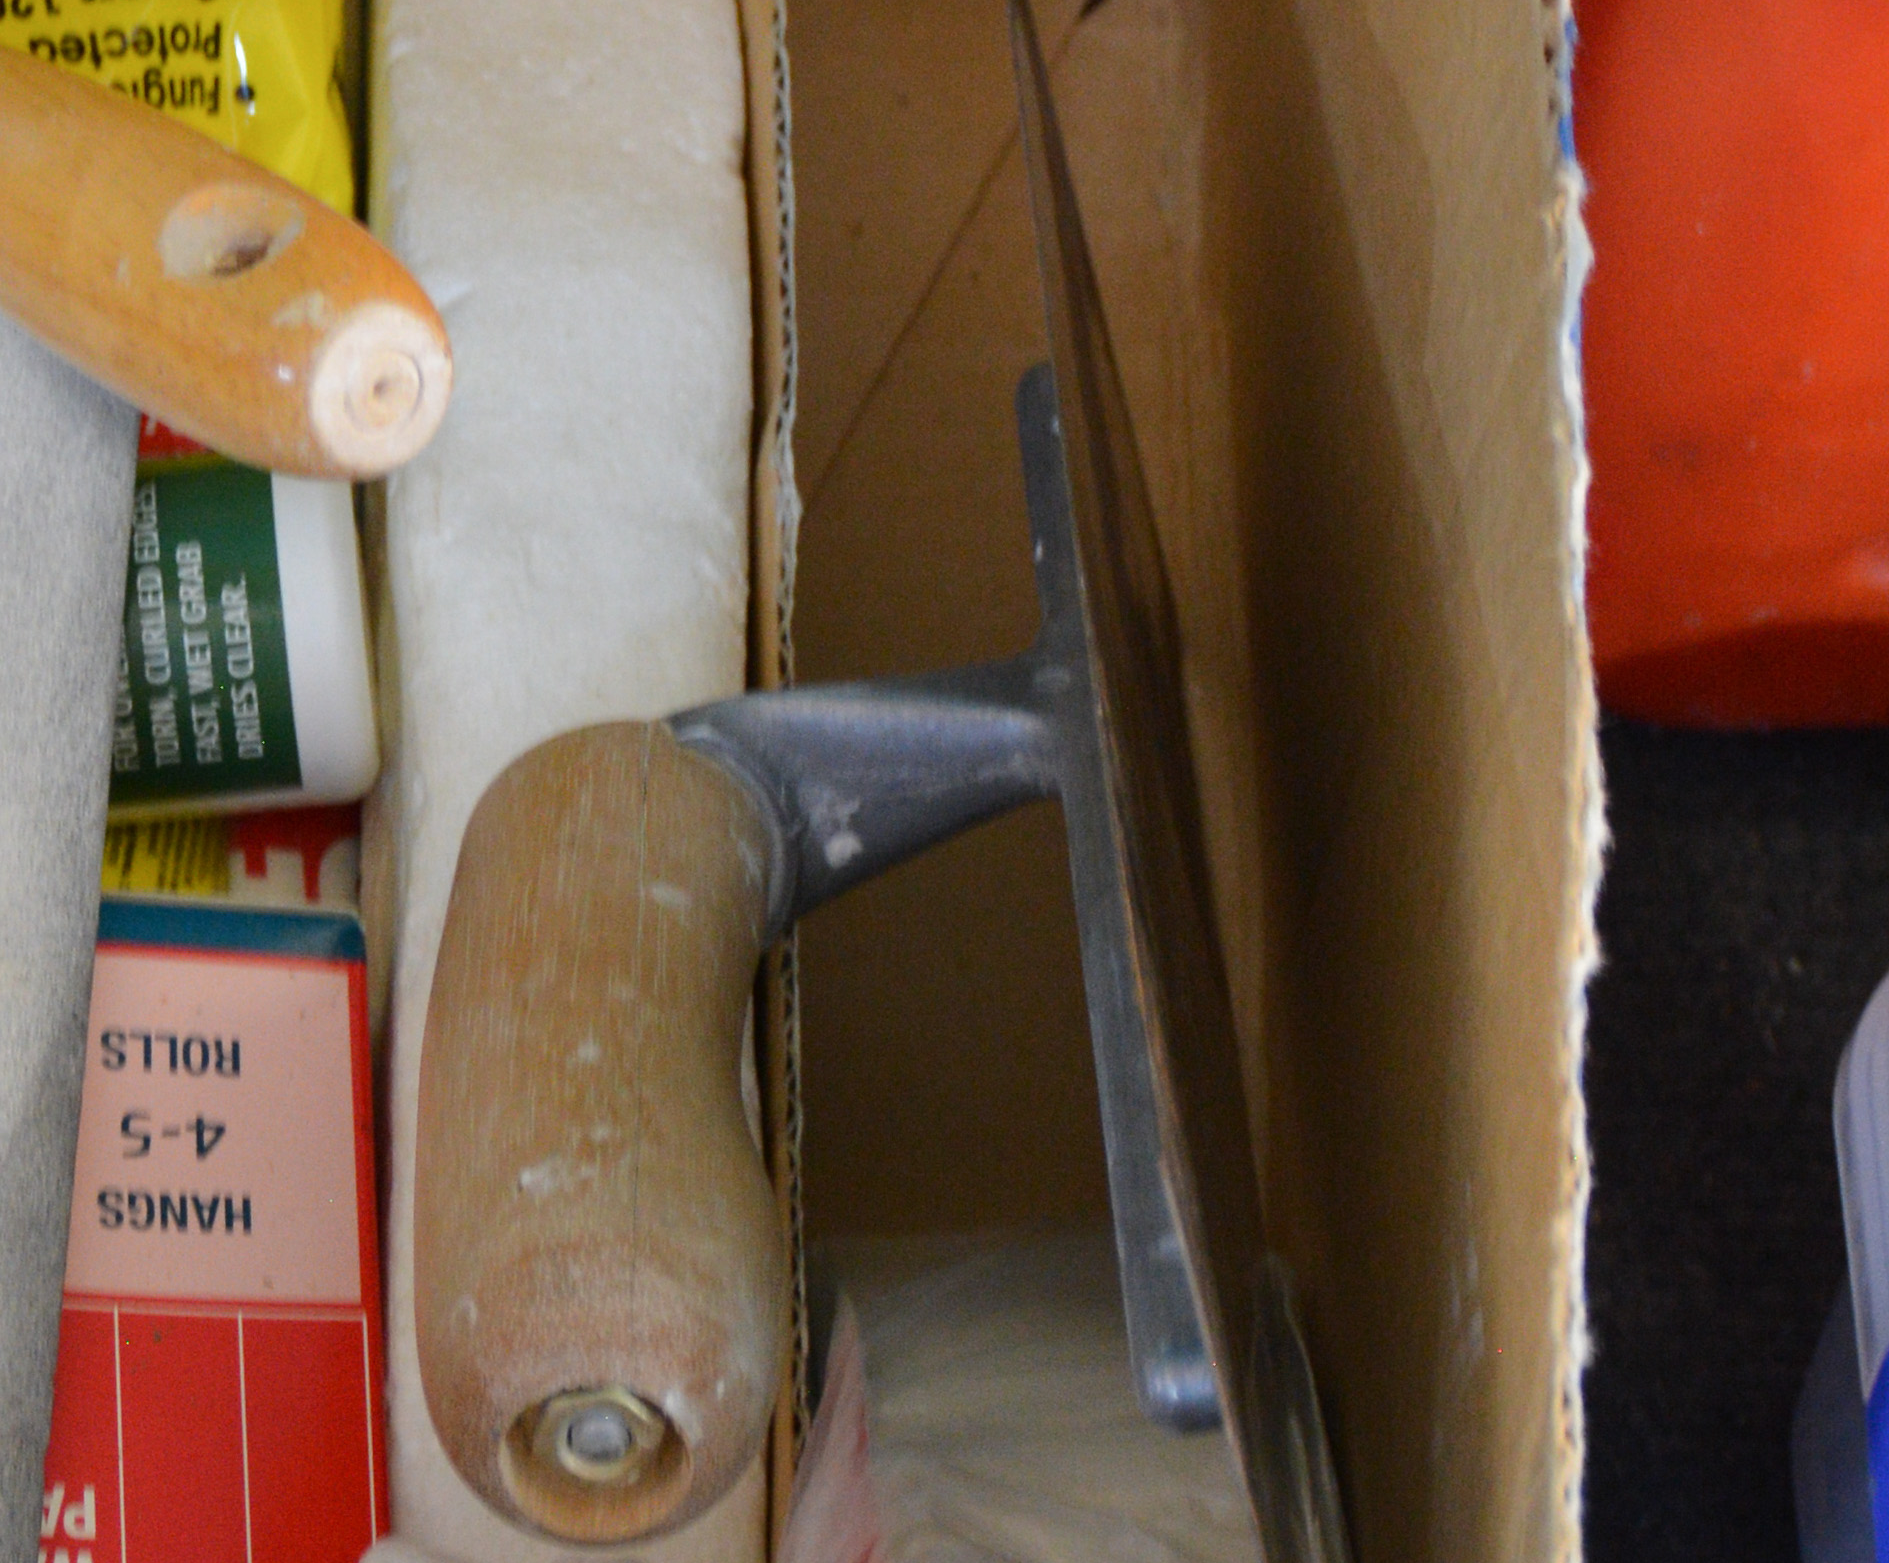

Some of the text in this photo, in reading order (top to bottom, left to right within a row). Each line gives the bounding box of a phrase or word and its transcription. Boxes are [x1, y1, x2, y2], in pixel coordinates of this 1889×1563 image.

[175, 541, 207, 624] GRAB
[136, 565, 171, 684] CURLED
[183, 629, 213, 695] WET
[230, 681, 263, 759] DRIES
[100, 1030, 241, 1078] ROLLS
[119, 1111, 226, 1161] 4-5
[96, 1189, 252, 1238] HANGS
